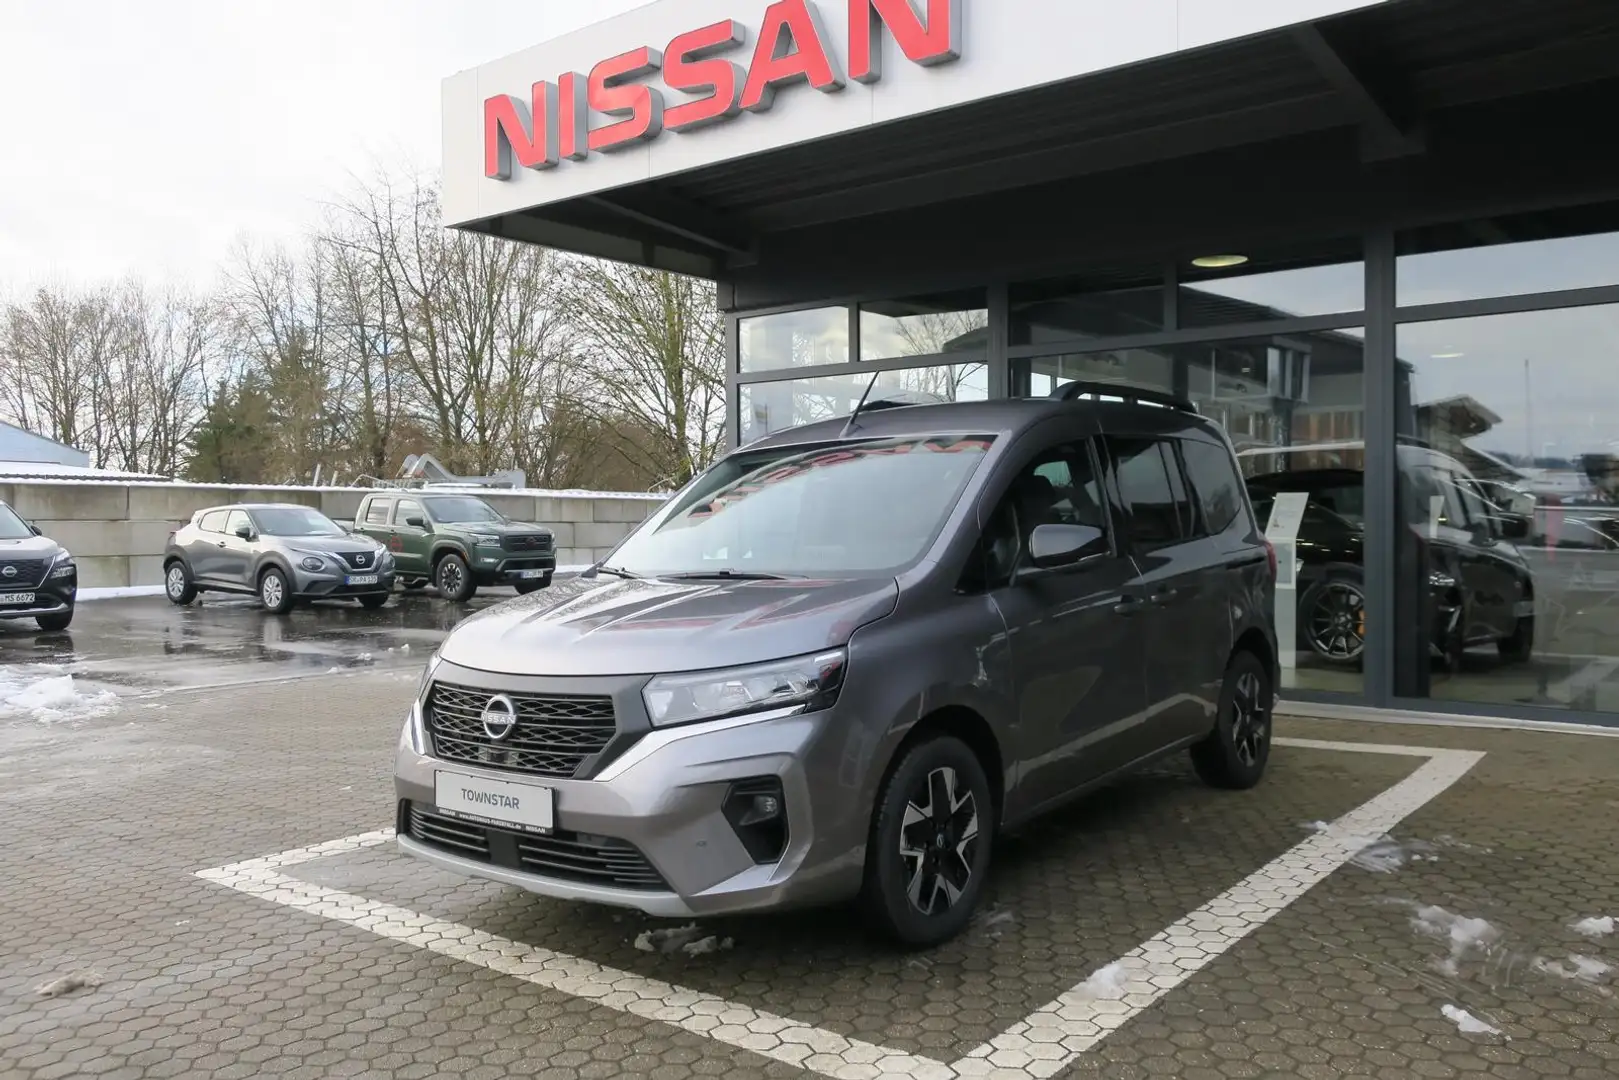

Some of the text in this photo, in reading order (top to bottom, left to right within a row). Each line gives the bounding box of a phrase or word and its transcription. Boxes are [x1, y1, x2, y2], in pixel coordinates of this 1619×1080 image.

[484, 0, 961, 180] NISSAN
[16, 593, 34, 602] 6672
[481, 712, 516, 725] NISSAN
[461, 788, 520, 809] TOWNSTAR
